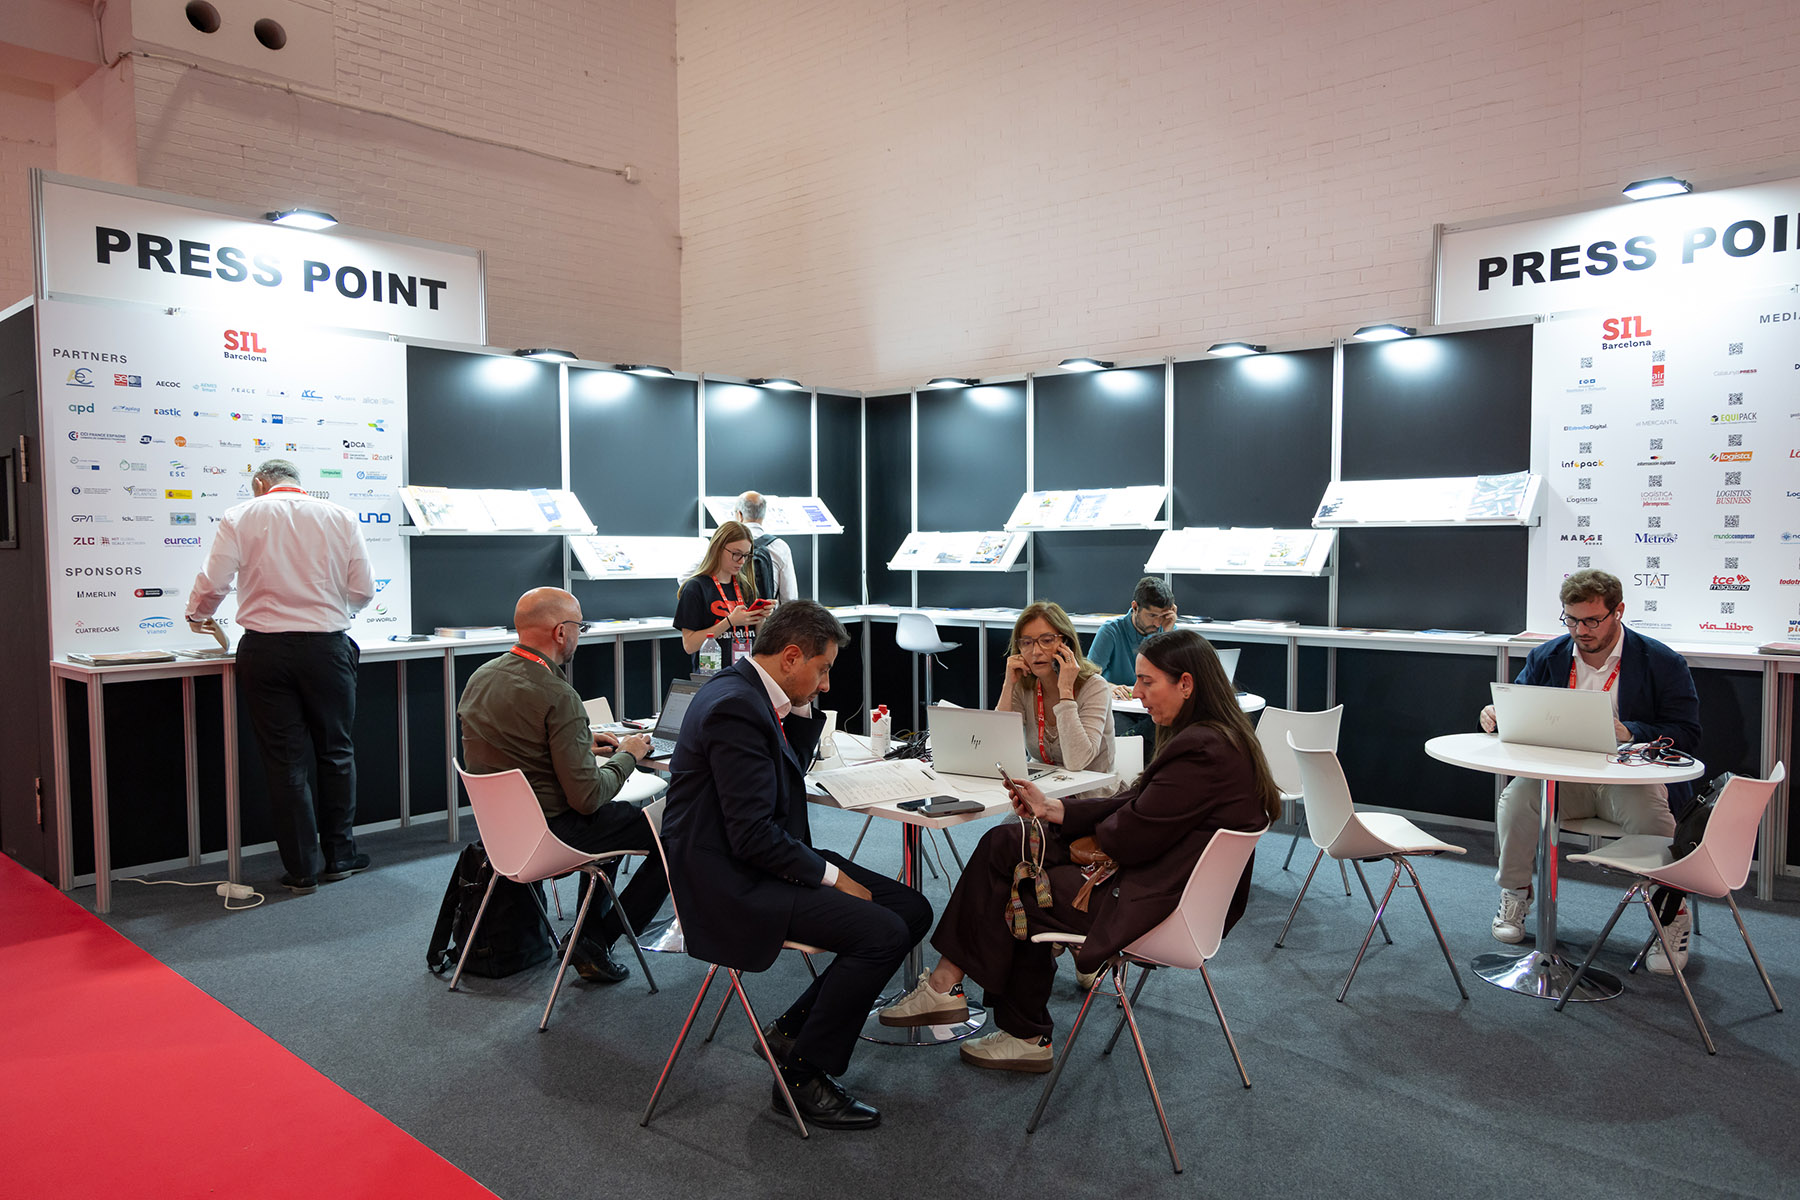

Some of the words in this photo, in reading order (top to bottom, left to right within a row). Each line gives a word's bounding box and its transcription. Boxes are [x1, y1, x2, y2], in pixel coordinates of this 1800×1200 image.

[1478, 235, 1657, 291] PRESS
[1682, 212, 1800, 265] POI
[95, 225, 283, 288] PRESS
[303, 259, 447, 311] POINT
[1759, 311, 1800, 324] MEDI
[1602, 315, 1652, 341] SIL
[223, 329, 267, 354] SIL
[1602, 339, 1652, 350] Barcelona
[52, 348, 128, 364] PARTNERS
[223, 351, 267, 363] Barcelona
[155, 380, 181, 388] AECOC
[68, 403, 95, 415] apd
[1720, 412, 1757, 422] EQUIPACK
[1561, 459, 1605, 469] infopack
[1716, 489, 1752, 497] LOGISTICS
[1716, 496, 1752, 505] BUSINESS
[73, 537, 95, 546] ZLC
[1560, 534, 1603, 542] MARGE
[65, 566, 142, 577] SPONSORS
[1633, 573, 1670, 587] STAT
[1712, 575, 1735, 585] tce
[85, 590, 117, 598] MERLIN
[75, 626, 120, 634] CUATRECASAS
